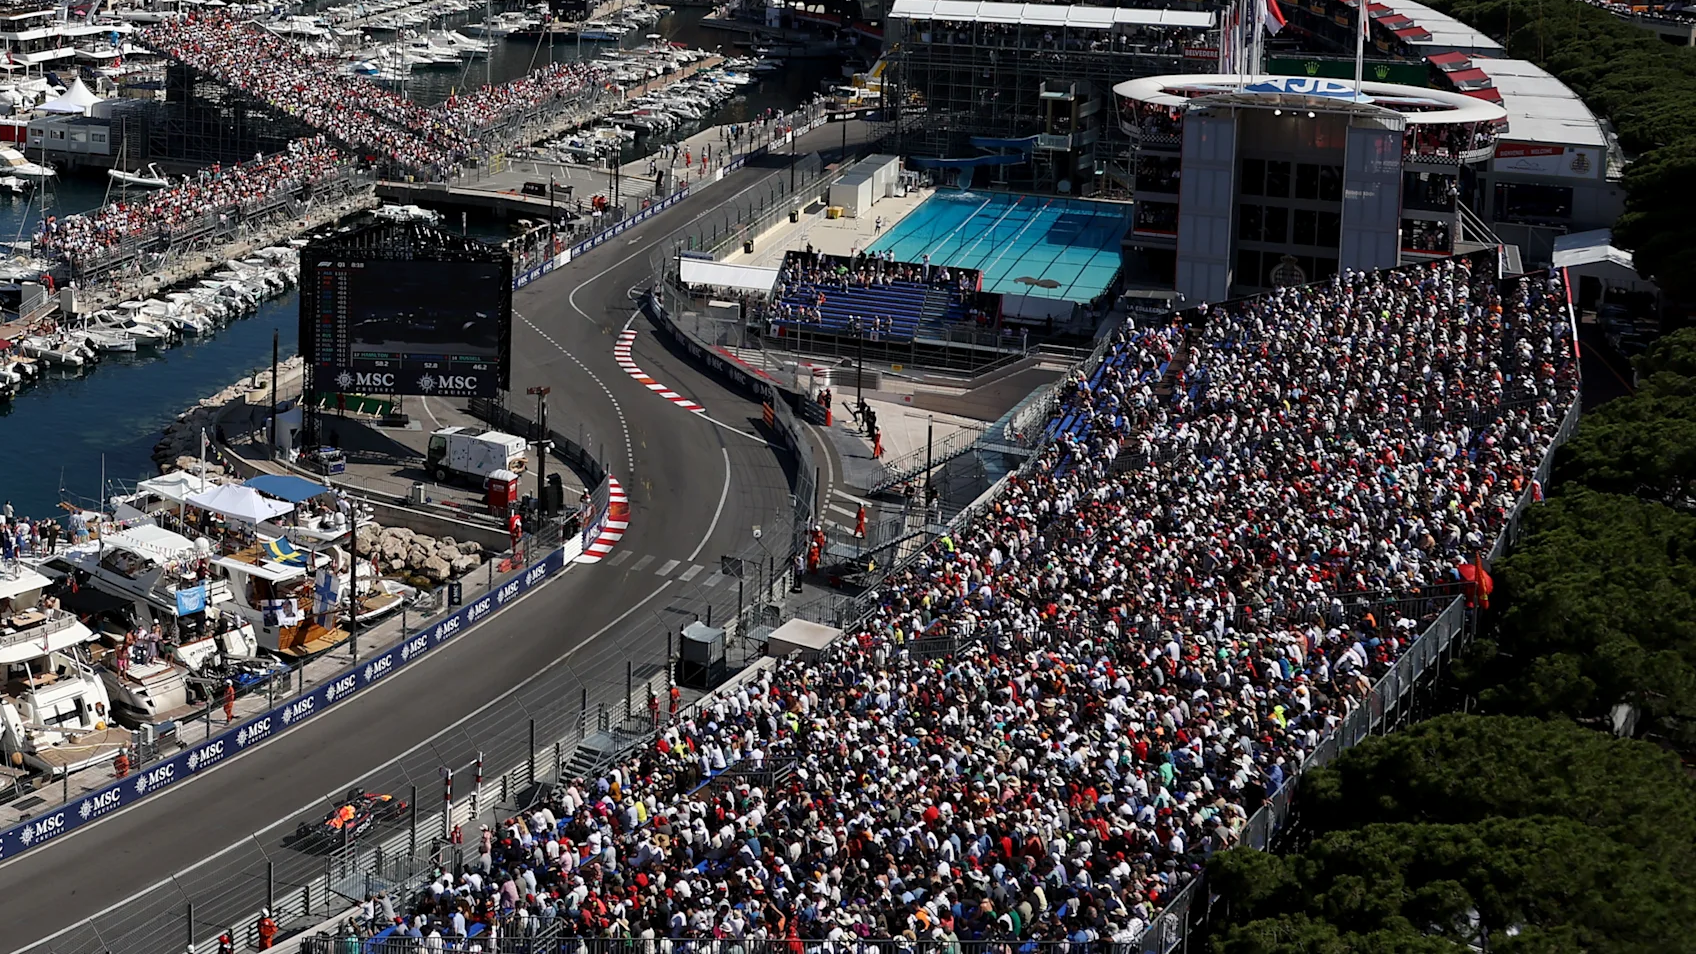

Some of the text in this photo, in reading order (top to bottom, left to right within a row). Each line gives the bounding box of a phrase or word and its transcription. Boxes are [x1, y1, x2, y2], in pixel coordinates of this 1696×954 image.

[1184, 49, 1219, 58] BELVEDERE
[356, 372, 395, 386] MSC
[438, 375, 477, 389] MSC
[531, 563, 546, 580] MSC
[504, 580, 519, 597] MSC
[474, 598, 491, 616] MSC
[443, 616, 460, 634] MSC
[409, 635, 428, 654] MSC
[373, 654, 392, 674] MSC
[336, 674, 355, 695] MSC
[292, 696, 314, 716] MSC
[248, 717, 271, 738] MSC
[199, 740, 224, 762] MSC
[148, 763, 174, 786] MSC
[93, 788, 121, 810] MSC
[35, 813, 65, 837] MSC
